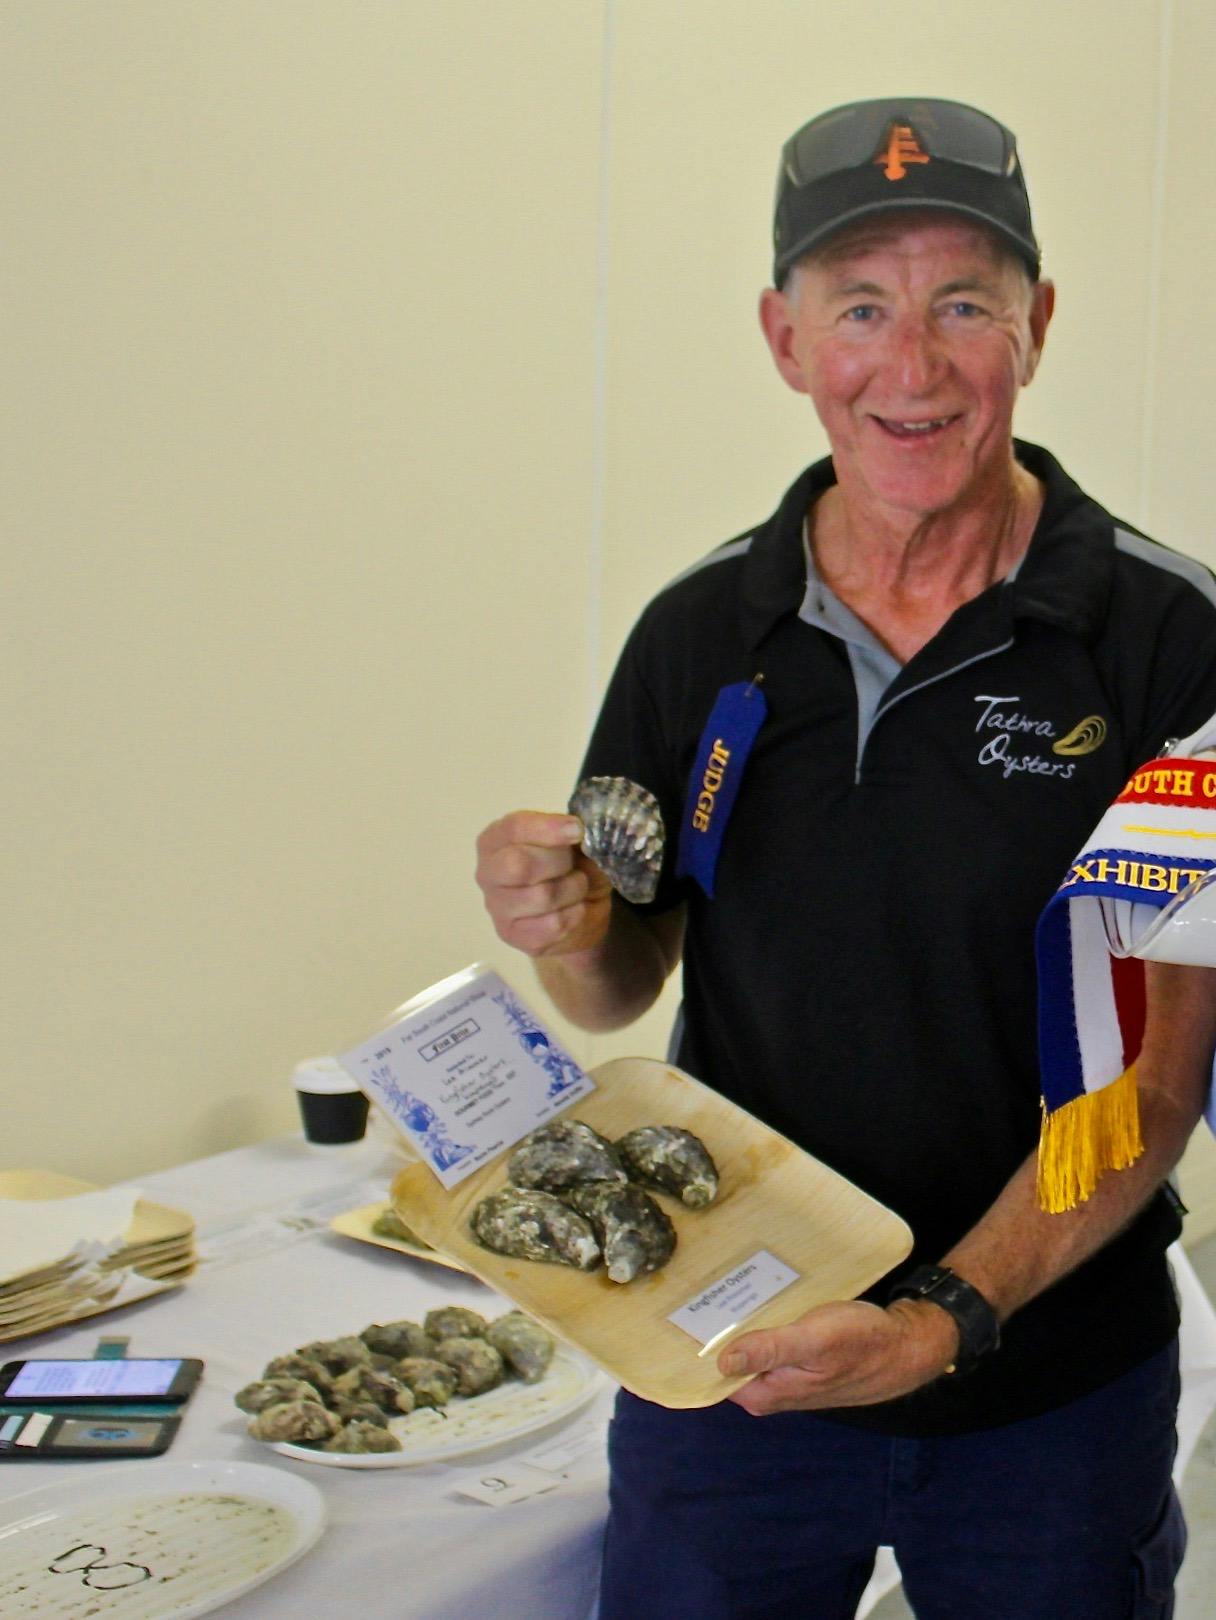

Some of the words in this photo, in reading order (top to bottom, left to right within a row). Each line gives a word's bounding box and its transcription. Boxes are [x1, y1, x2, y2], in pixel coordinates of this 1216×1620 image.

[974, 695, 1056, 737] Tathra
[978, 733, 1076, 779] Oysters
[691, 738, 731, 833] JUDGE
[1067, 857, 1208, 894] XHIBIT
